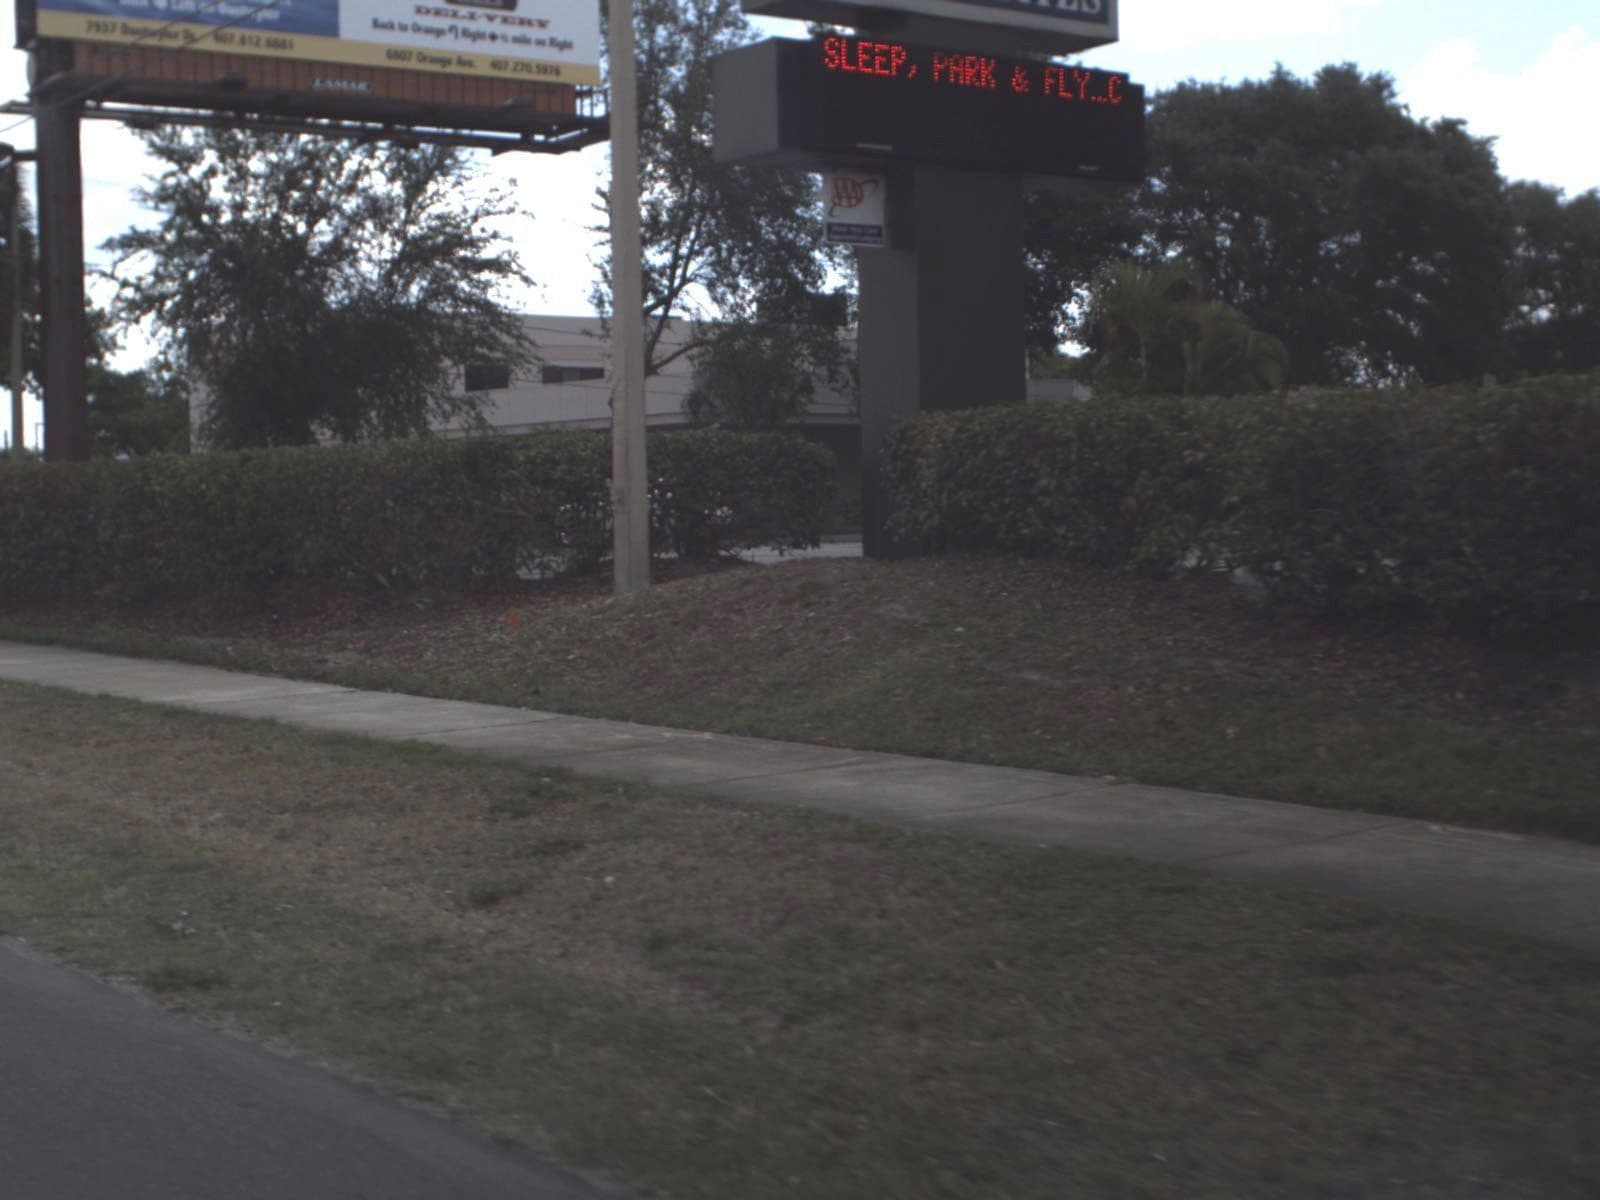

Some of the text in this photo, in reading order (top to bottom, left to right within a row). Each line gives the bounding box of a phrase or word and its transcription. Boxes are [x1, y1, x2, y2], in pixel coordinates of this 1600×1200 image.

[371, 17, 396, 31] Back
[398, 21, 409, 32] to
[411, 21, 447, 39] Orange
[461, 27, 487, 42] Right
[549, 37, 573, 52] Right
[416, 51, 453, 68] Orange
[824, 37, 917, 79] SLEEP,
[931, 53, 997, 89] PARK
[1011, 66, 1029, 94] &
